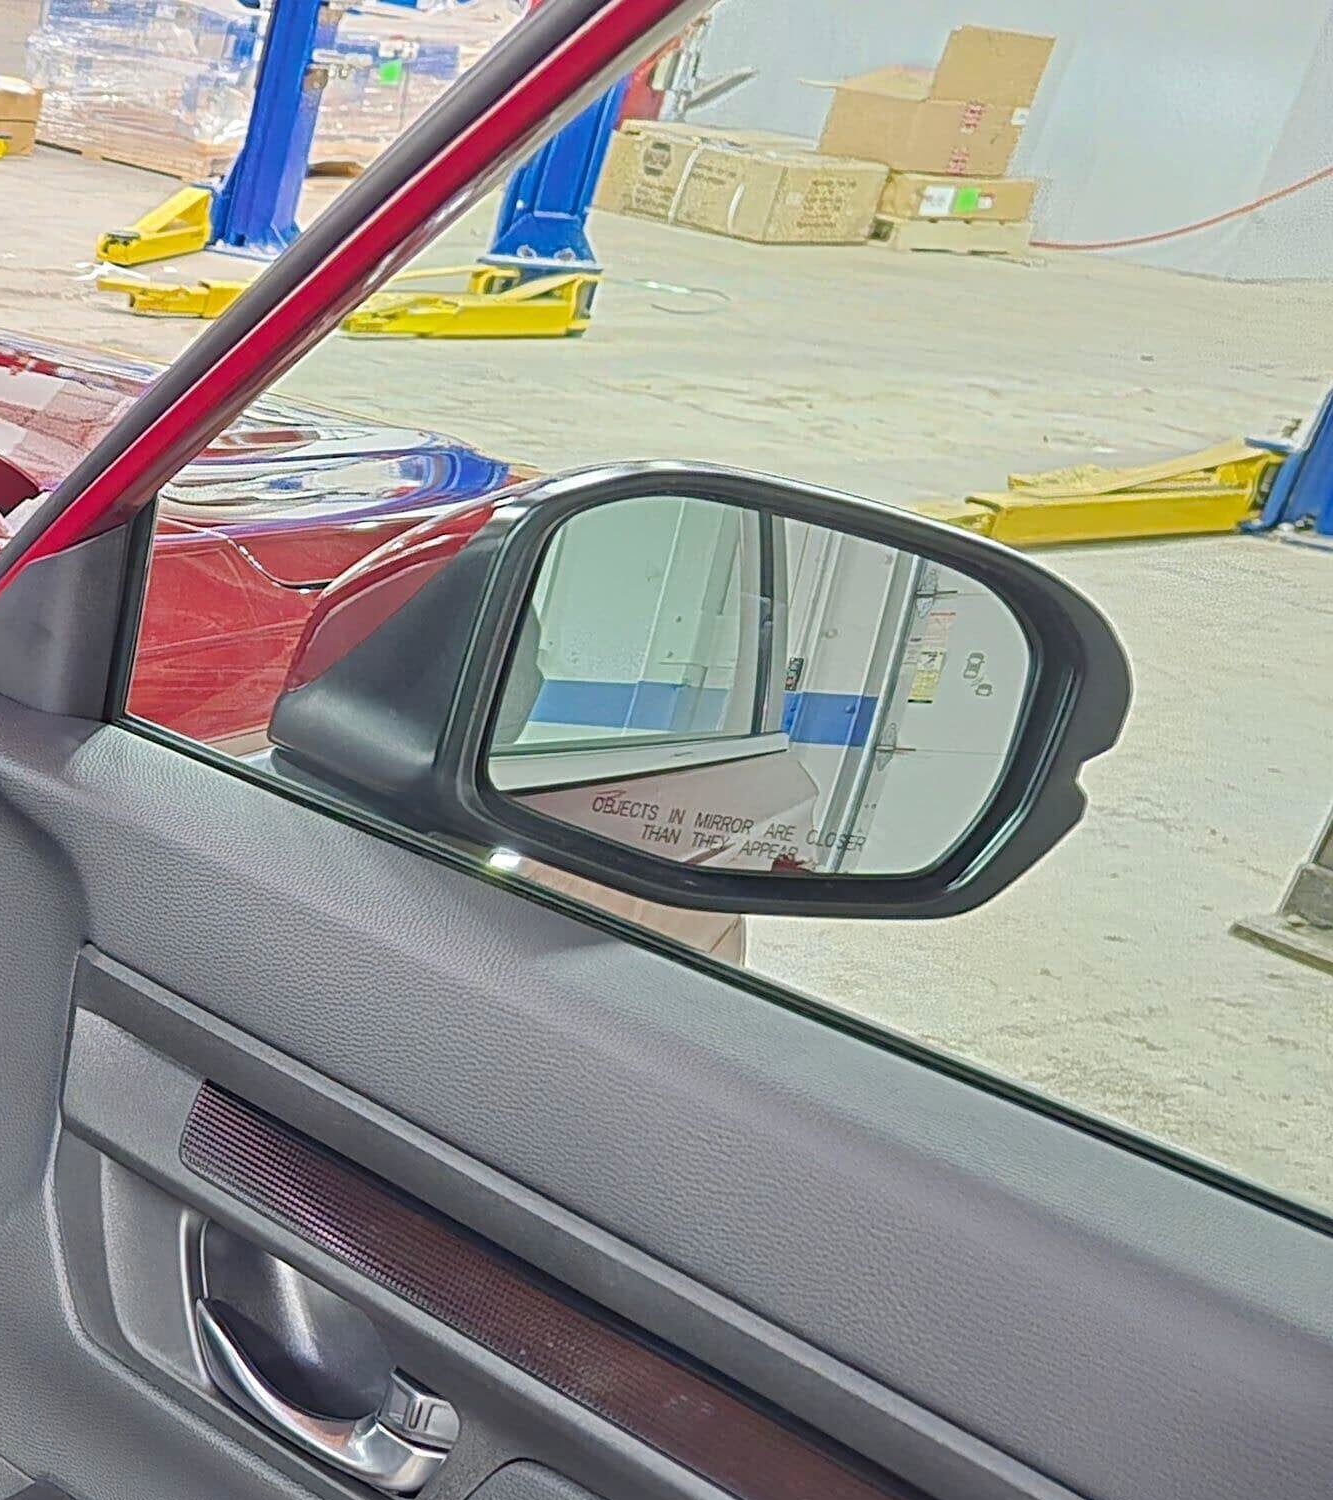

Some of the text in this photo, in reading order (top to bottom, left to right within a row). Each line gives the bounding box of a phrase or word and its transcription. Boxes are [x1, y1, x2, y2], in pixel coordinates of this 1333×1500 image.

[592, 796, 866, 852] OBJECTS IN MIRROR ARE CLOSER
[642, 825, 798, 860] THAN THEY APPEAR
